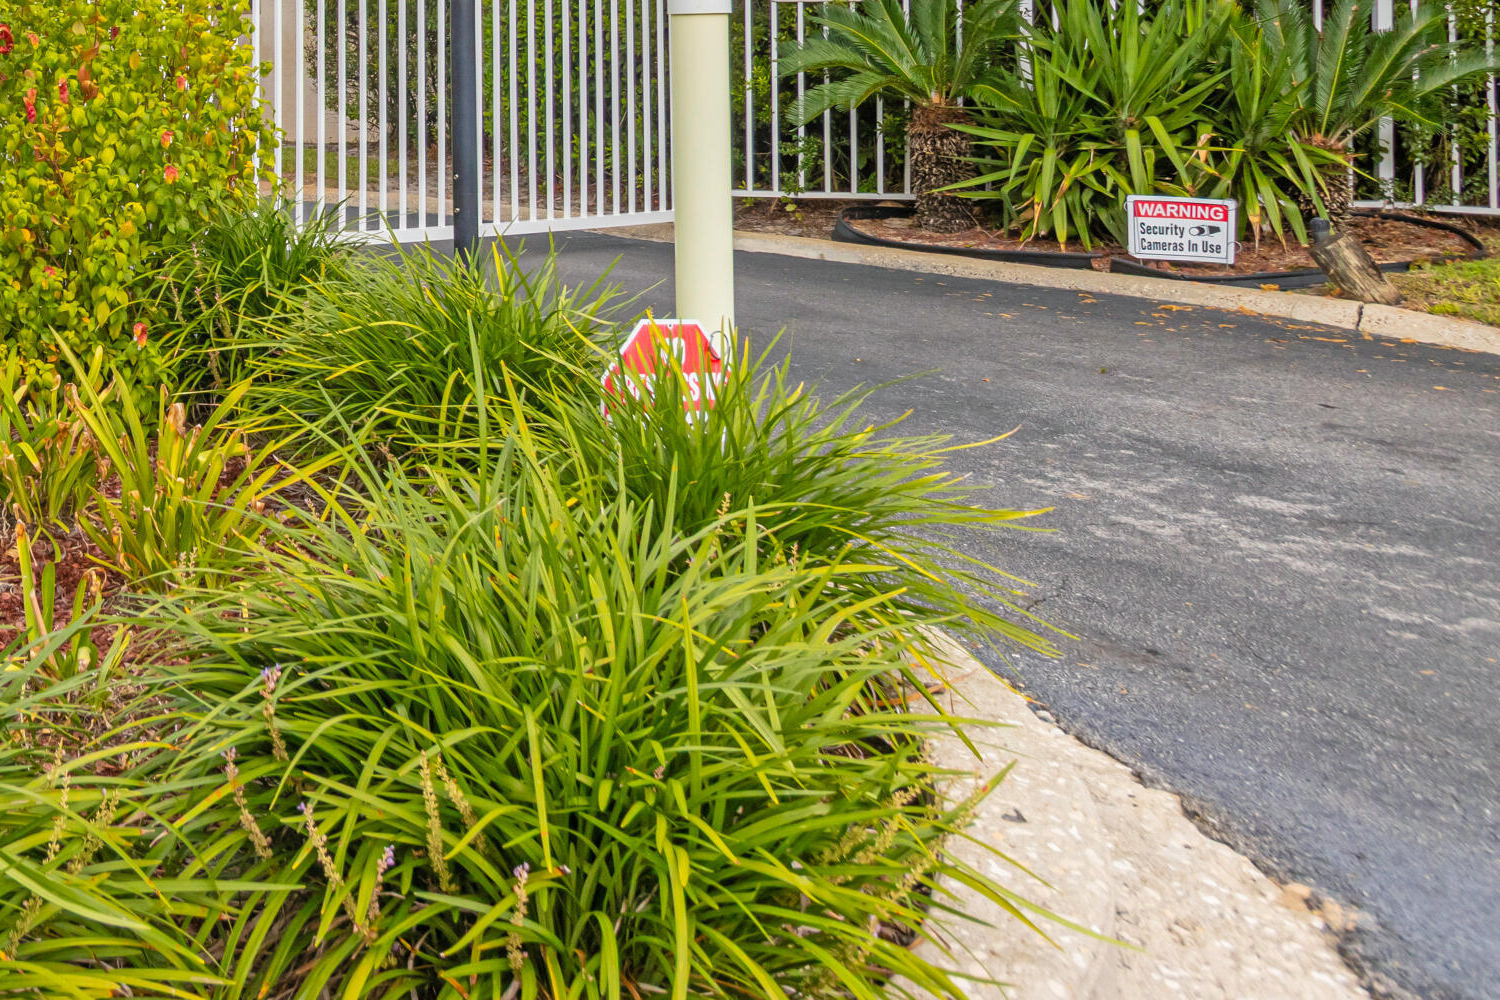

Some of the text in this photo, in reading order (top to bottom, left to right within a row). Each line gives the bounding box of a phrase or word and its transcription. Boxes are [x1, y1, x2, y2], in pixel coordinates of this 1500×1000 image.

[1138, 203, 1224, 220] WARNING
[1140, 222, 1185, 238] Security
[1141, 238, 1222, 254] Cameras In Use
